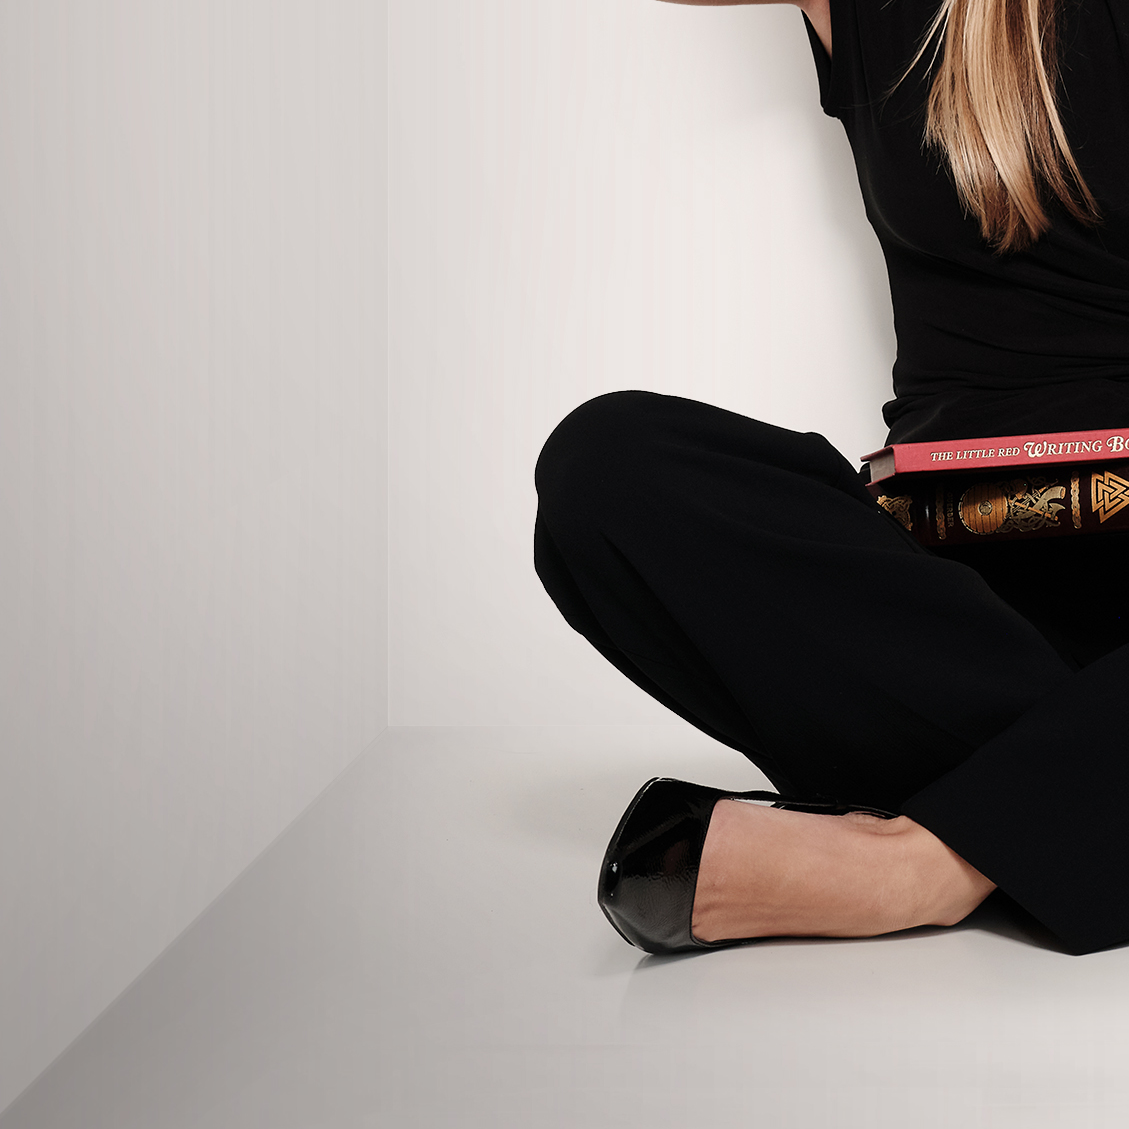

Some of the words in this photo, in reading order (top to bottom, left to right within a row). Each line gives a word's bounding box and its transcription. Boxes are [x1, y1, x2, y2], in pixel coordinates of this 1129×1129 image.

[931, 452, 953, 461] THE
[956, 449, 995, 460] LITTLE
[997, 447, 1020, 457] RED
[1023, 440, 1102, 458] WRITING
